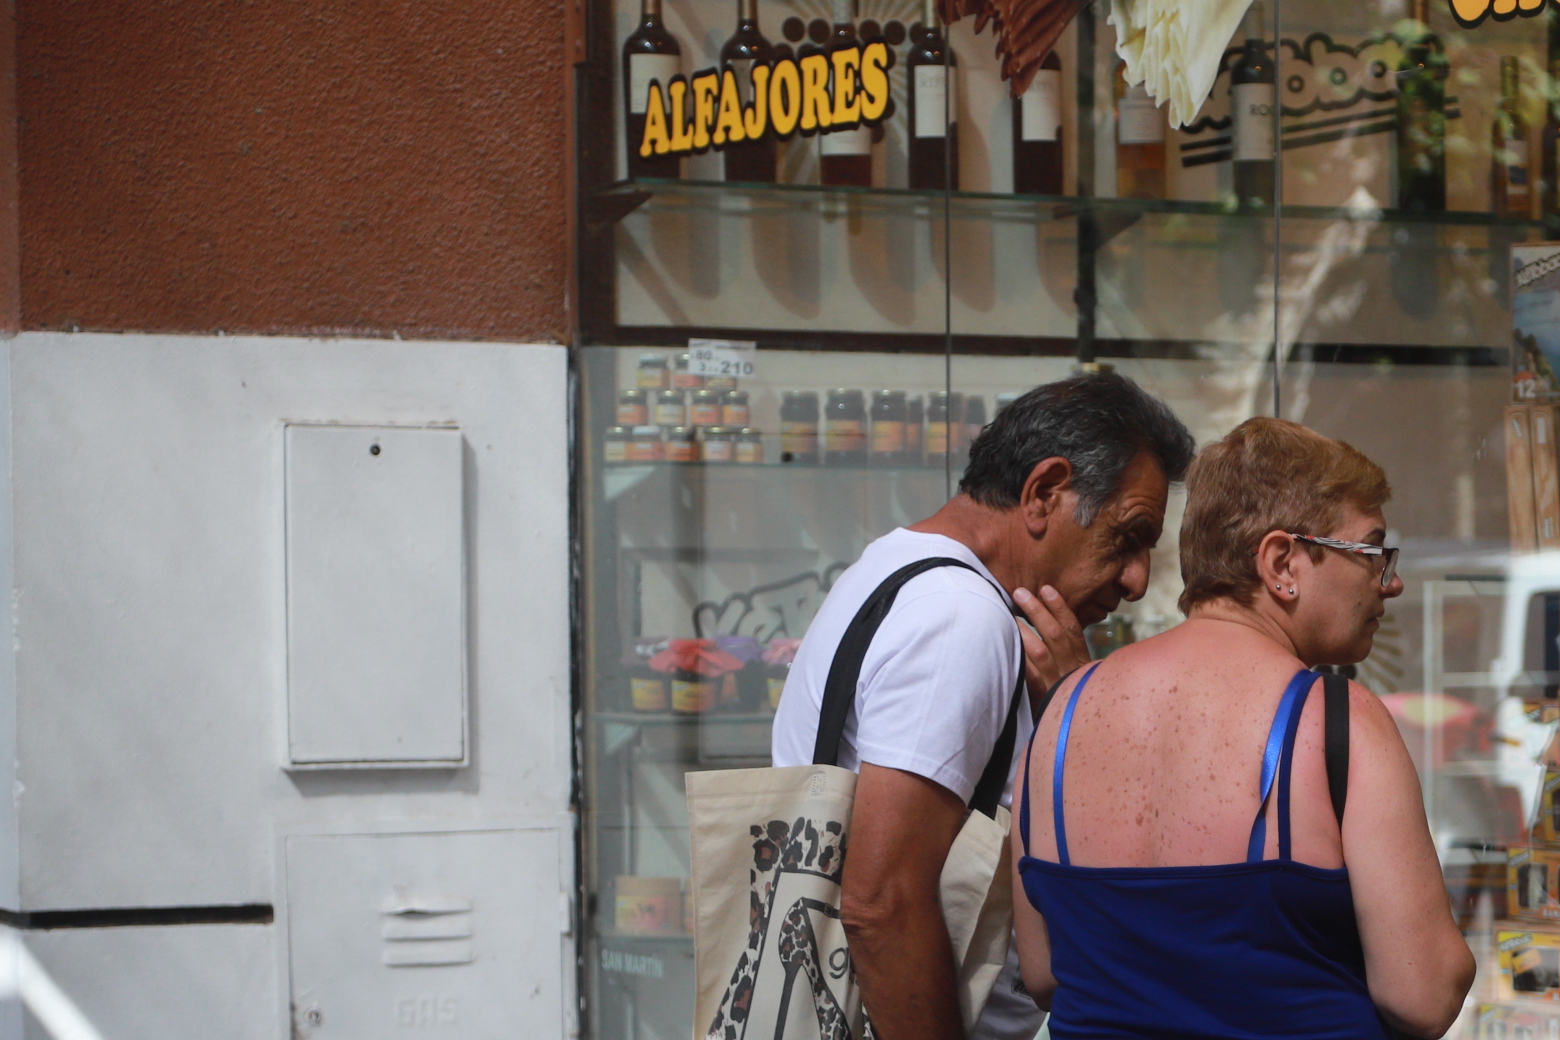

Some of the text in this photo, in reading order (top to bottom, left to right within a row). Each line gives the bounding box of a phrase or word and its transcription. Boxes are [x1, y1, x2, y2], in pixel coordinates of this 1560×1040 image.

[638, 42, 889, 158] ALFAJORES
[721, 361, 754, 375] 210
[1515, 379, 1537, 398] 12
[602, 949, 622, 972] SAN
[397, 995, 460, 1028] GAS
